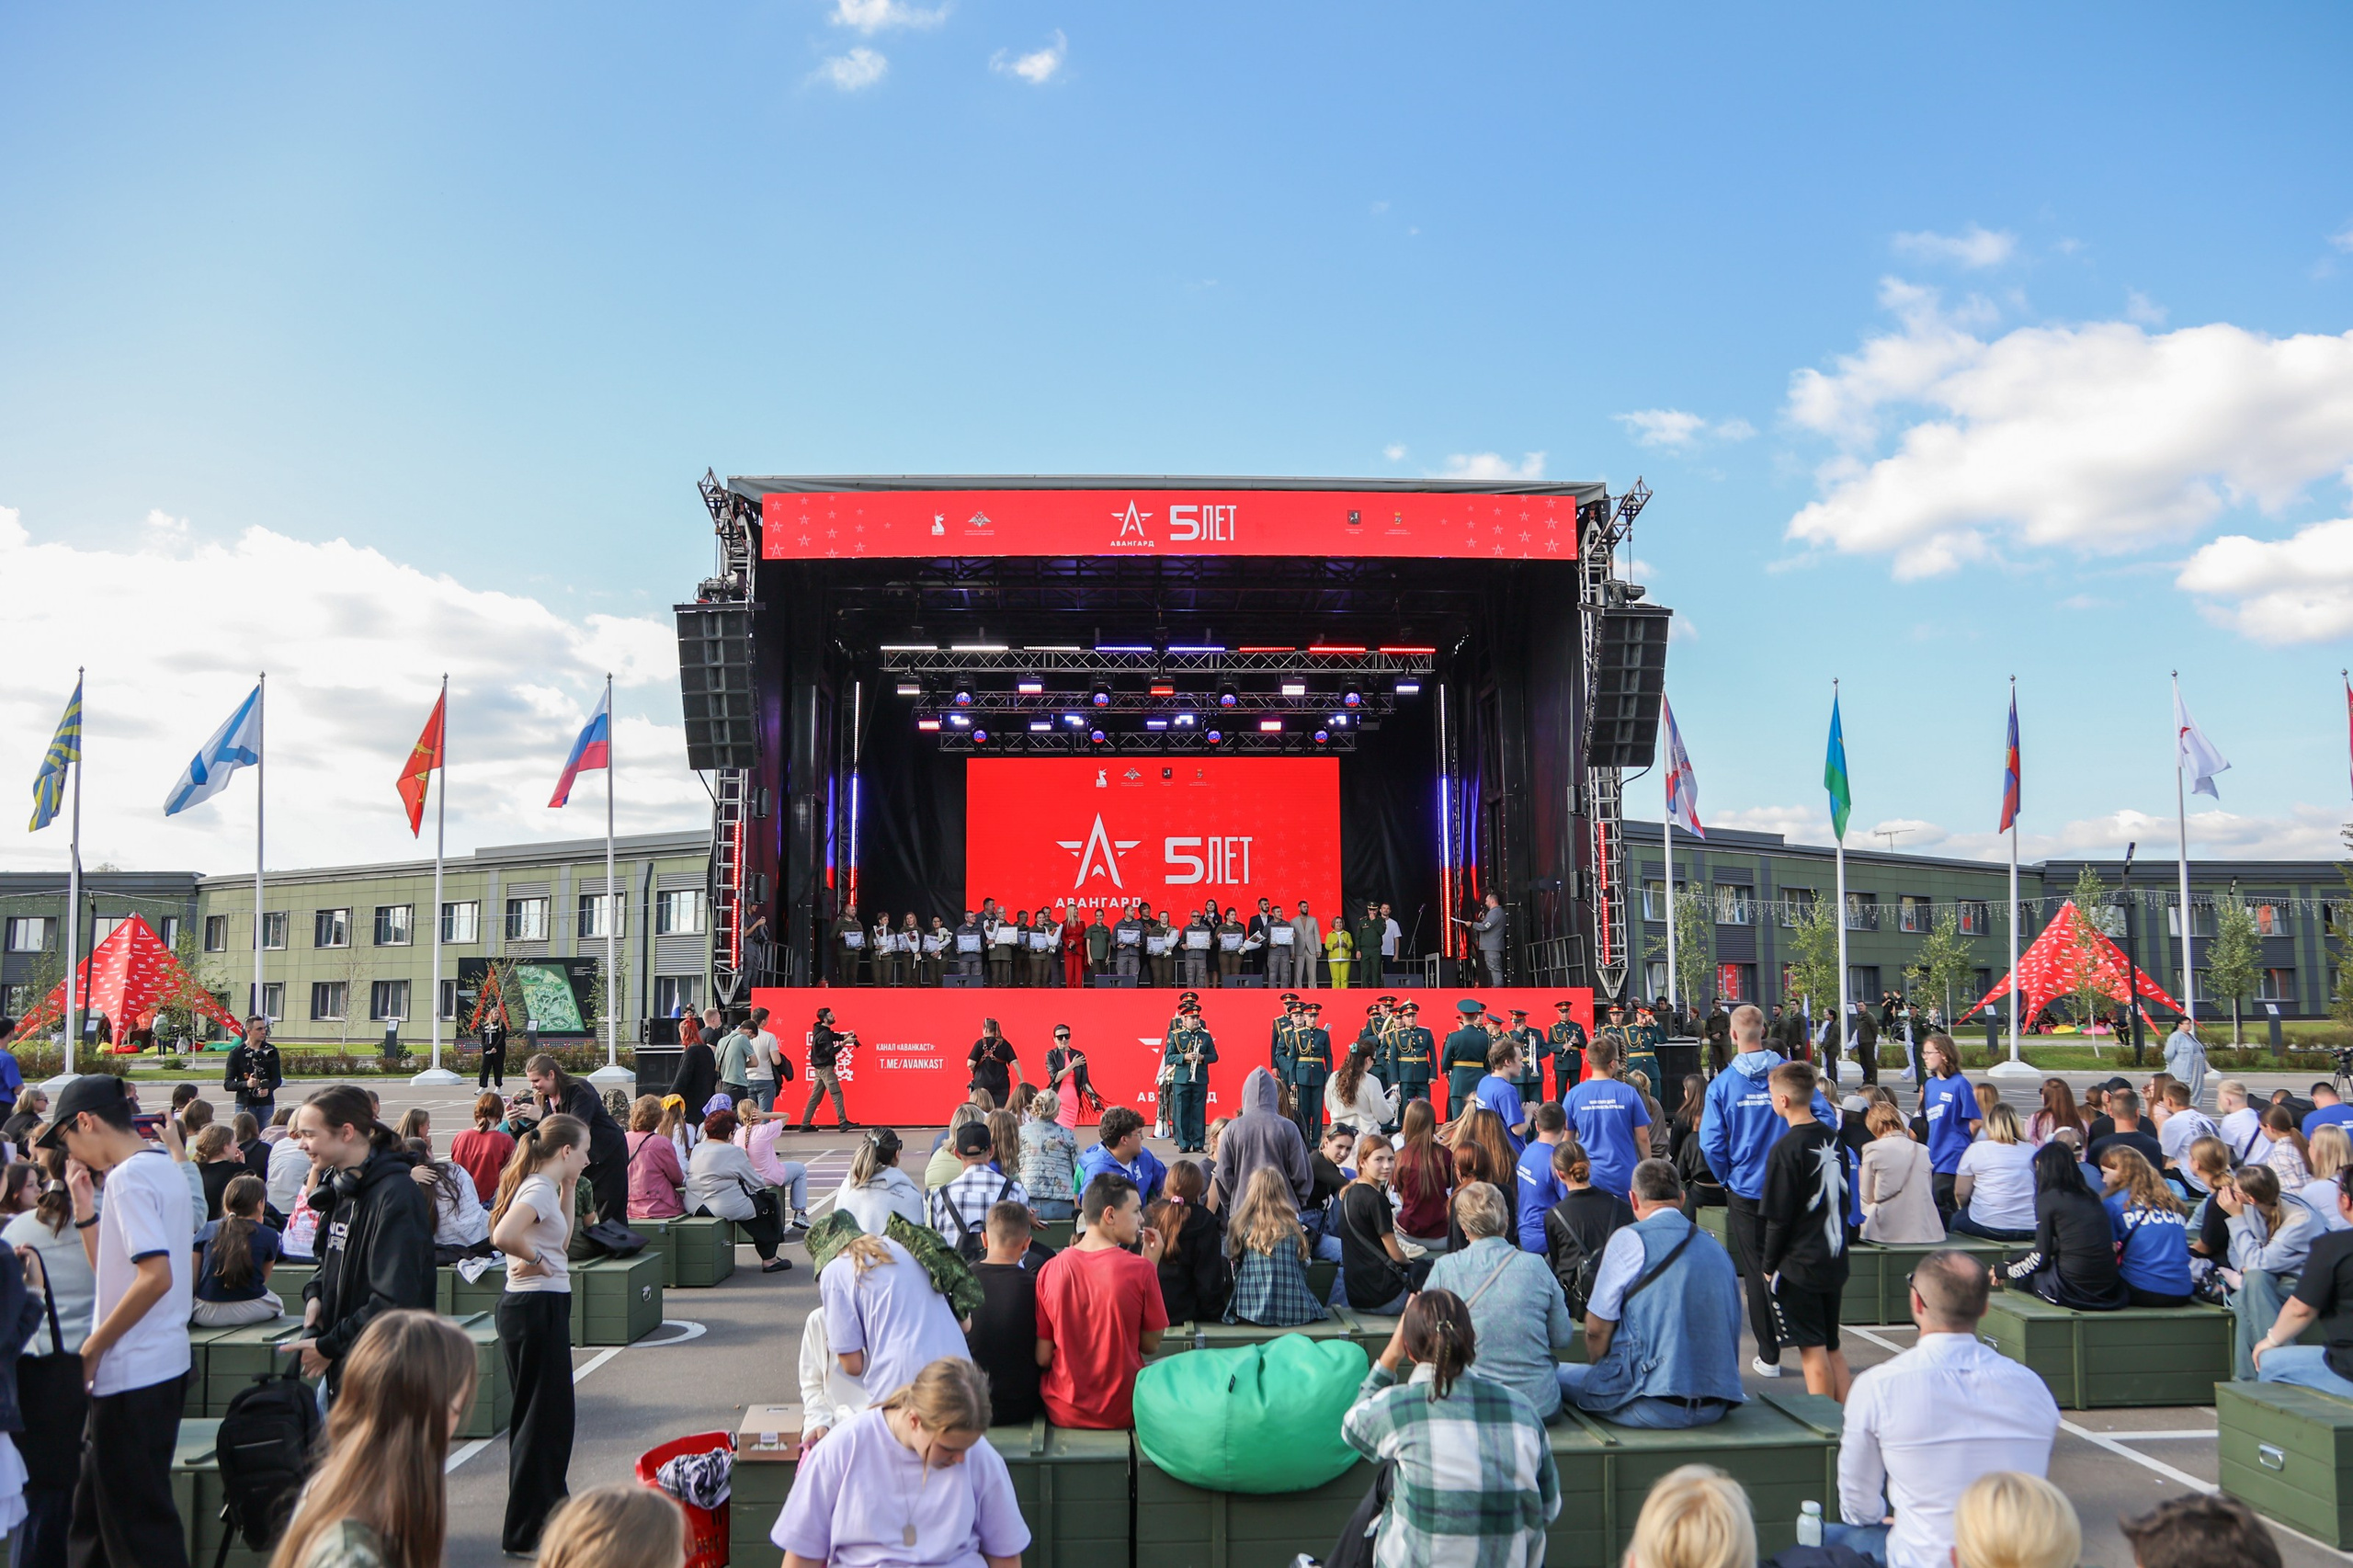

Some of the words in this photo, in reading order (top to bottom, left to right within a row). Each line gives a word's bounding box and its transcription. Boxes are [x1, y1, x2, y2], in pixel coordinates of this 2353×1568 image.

[1054, 897, 1142, 908] АВАНГАРД
[876, 1043, 896, 1051] КАНАЛ
[880, 1059, 944, 1070] T.ME/AVANKAST
